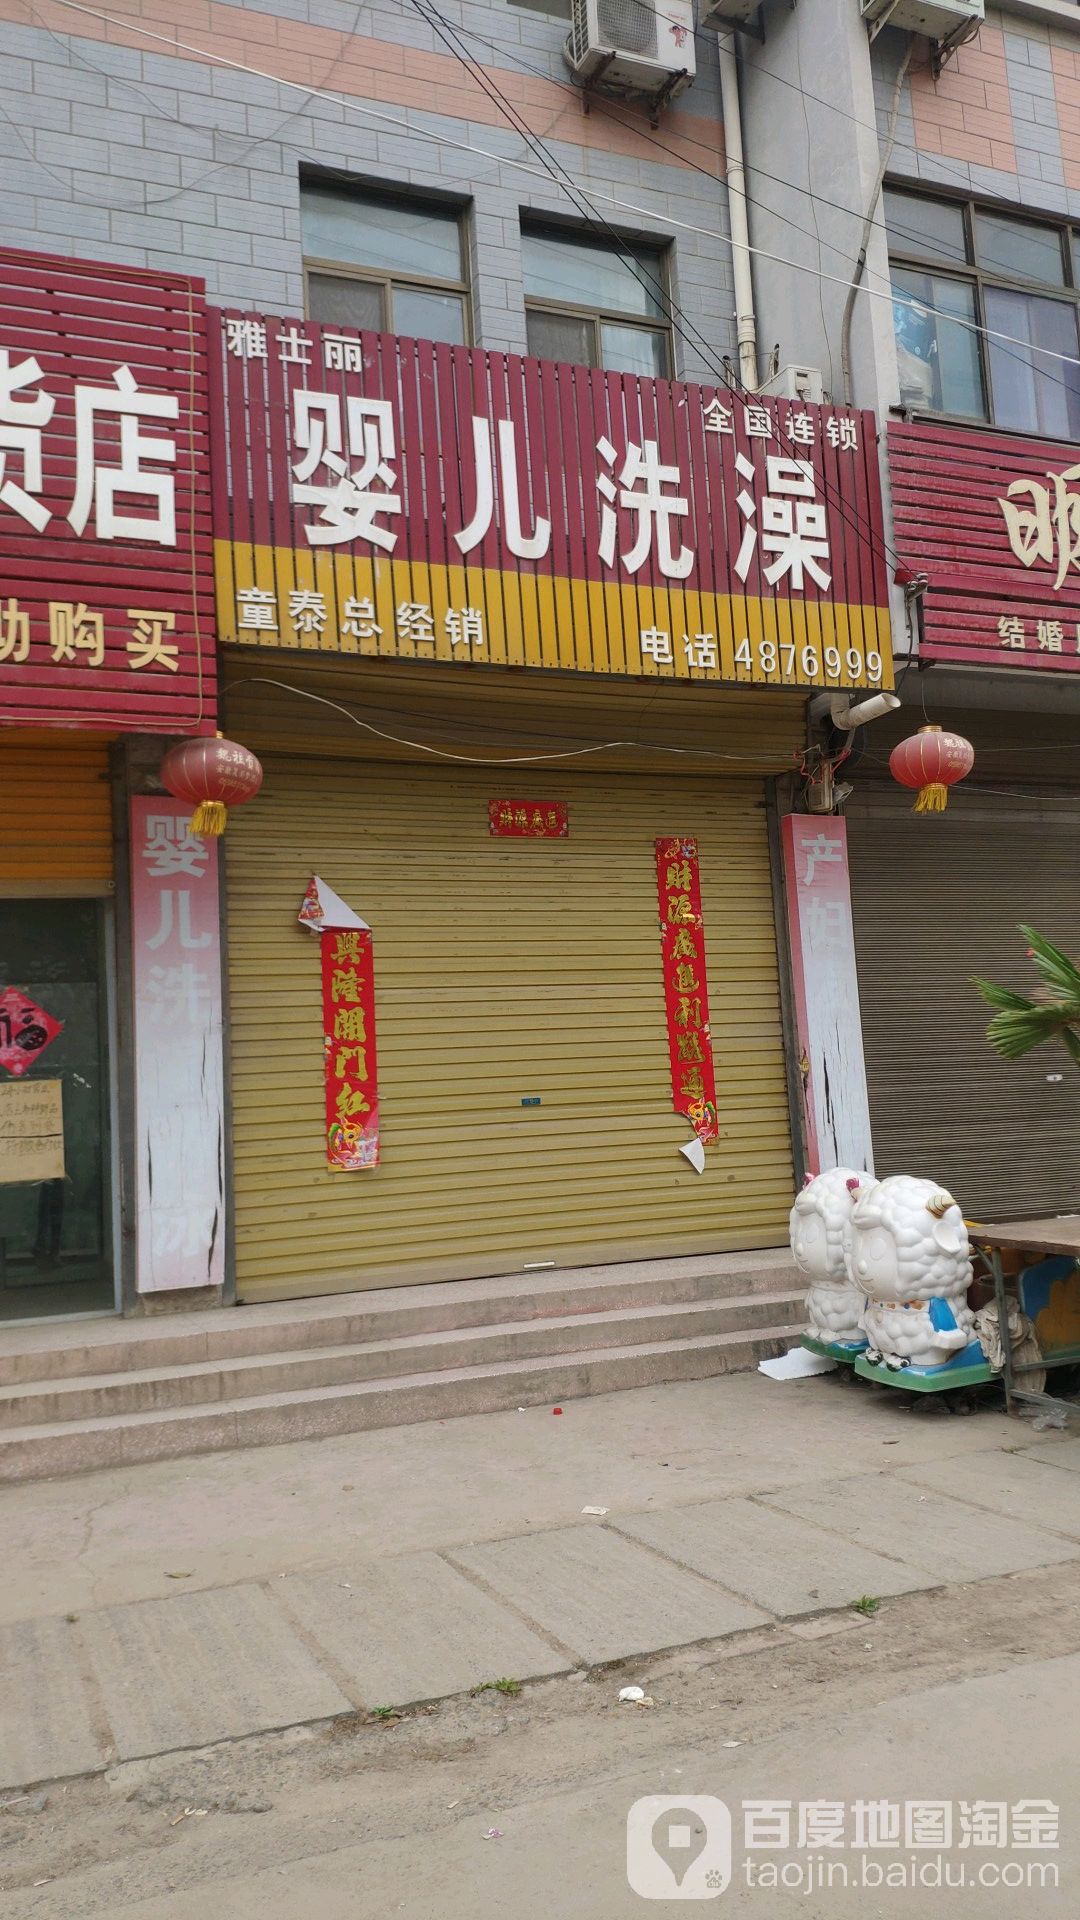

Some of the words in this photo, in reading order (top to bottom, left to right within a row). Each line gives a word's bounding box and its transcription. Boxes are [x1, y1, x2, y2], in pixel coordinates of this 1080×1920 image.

[226, 318, 363, 374] 雅士丽
[703, 398, 859, 451] 全国连锁
[291, 388, 833, 594] 婴儿洗澡
[236, 586, 484, 647] 童泰总经销
[997, 614, 1080, 654] 结婚
[640, 625, 718, 669] 电话
[734, 637, 884, 683] 4876999
